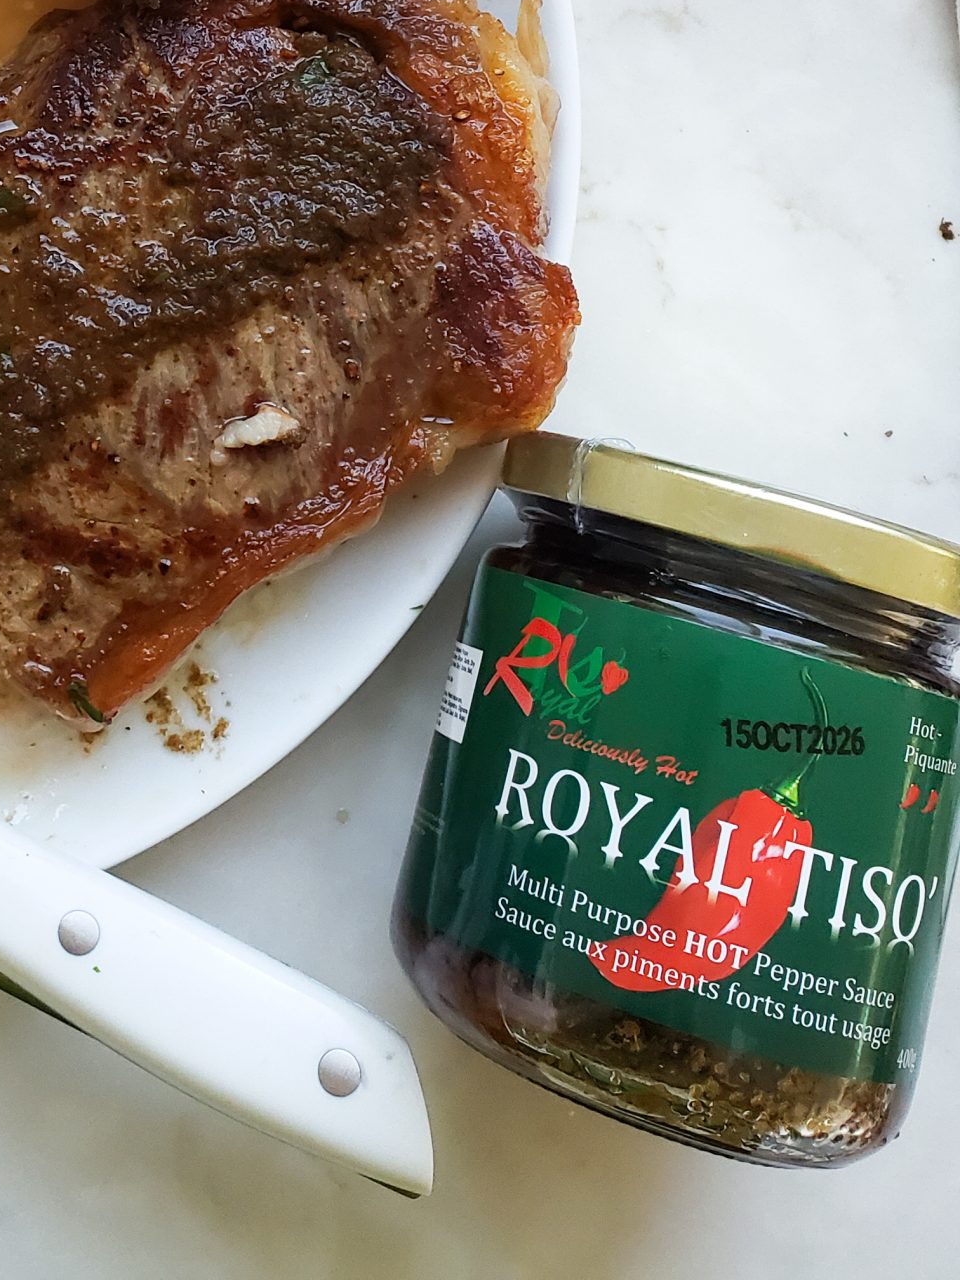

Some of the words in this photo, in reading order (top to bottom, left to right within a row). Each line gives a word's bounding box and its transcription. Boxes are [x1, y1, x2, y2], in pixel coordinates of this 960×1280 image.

[547, 720, 649, 773] Deliciously
[655, 755, 698, 785] Hot
[720, 717, 865, 756] 15OCT2026
[903, 744, 957, 776] Piquante
[495, 748, 752, 906] ROYAL
[495, 896, 557, 940] Sauce
[561, 930, 608, 962] aux
[610, 947, 721, 1001] piments
[726, 982, 786, 1021] forts
[792, 1003, 838, 1035] tout
[841, 1018, 891, 1050] usage
[507, 863, 565, 907] Multi
[571, 889, 677, 948] Purpose
[683, 929, 749, 970] HOT
[753, 952, 839, 996] Pepper
[842, 977, 895, 1010] Sauce
